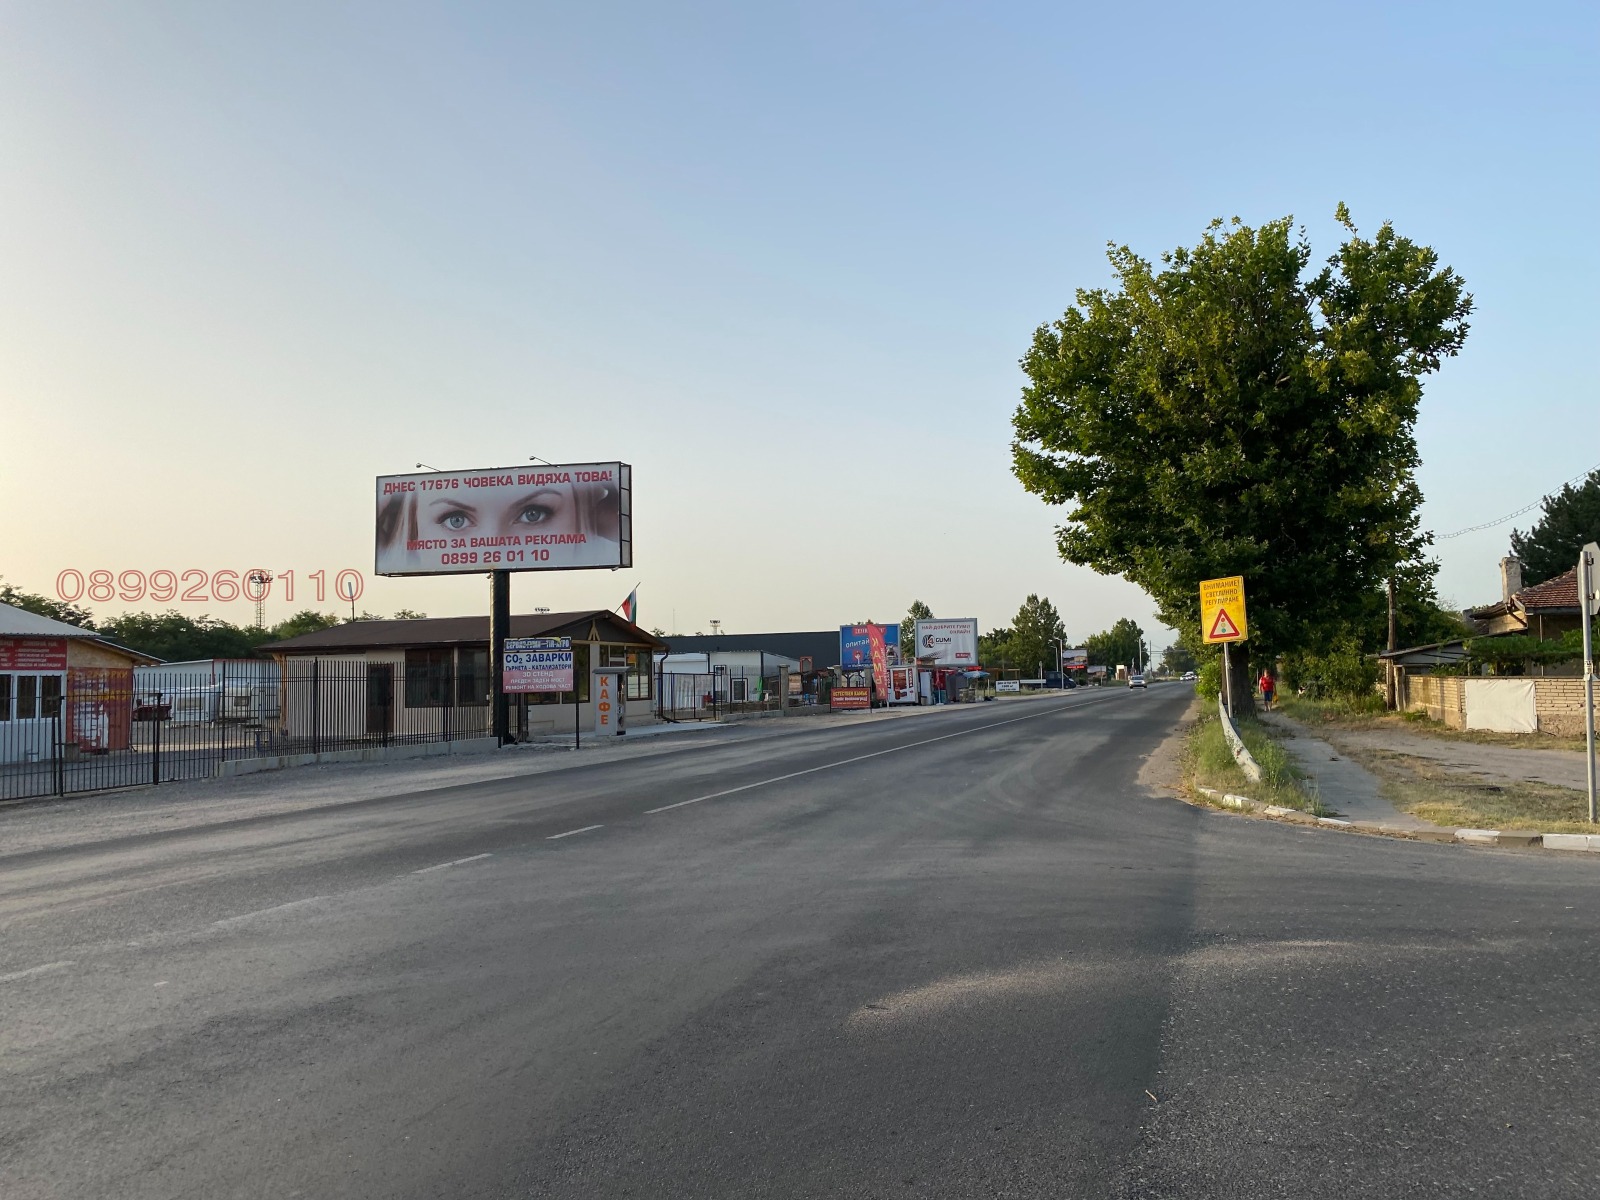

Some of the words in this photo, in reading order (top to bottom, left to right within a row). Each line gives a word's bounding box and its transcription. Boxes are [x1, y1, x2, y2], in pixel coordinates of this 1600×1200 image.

[384, 481, 416, 495] ДНЕС
[420, 478, 458, 491] 17676
[464, 476, 514, 489] ЧОВЕКА
[518, 472, 570, 487] ВИДЯХА
[575, 470, 612, 483] ТОВА!
[407, 540, 447, 550] МЯСТО
[451, 538, 466, 549] ЗА
[470, 536, 522, 548] ВАШАТА
[524, 533, 587, 546] РЕКЛАМА
[441, 551, 478, 564] 0899
[483, 551, 501, 563] 26
[506, 550, 525, 562] 01
[532, 549, 550, 561] 10
[1204, 580, 1240, 590] ВНИМАНИЕ!
[526, 653, 572, 662] ЗАВАРКИ
[599, 677, 610, 725] КАФЕ
